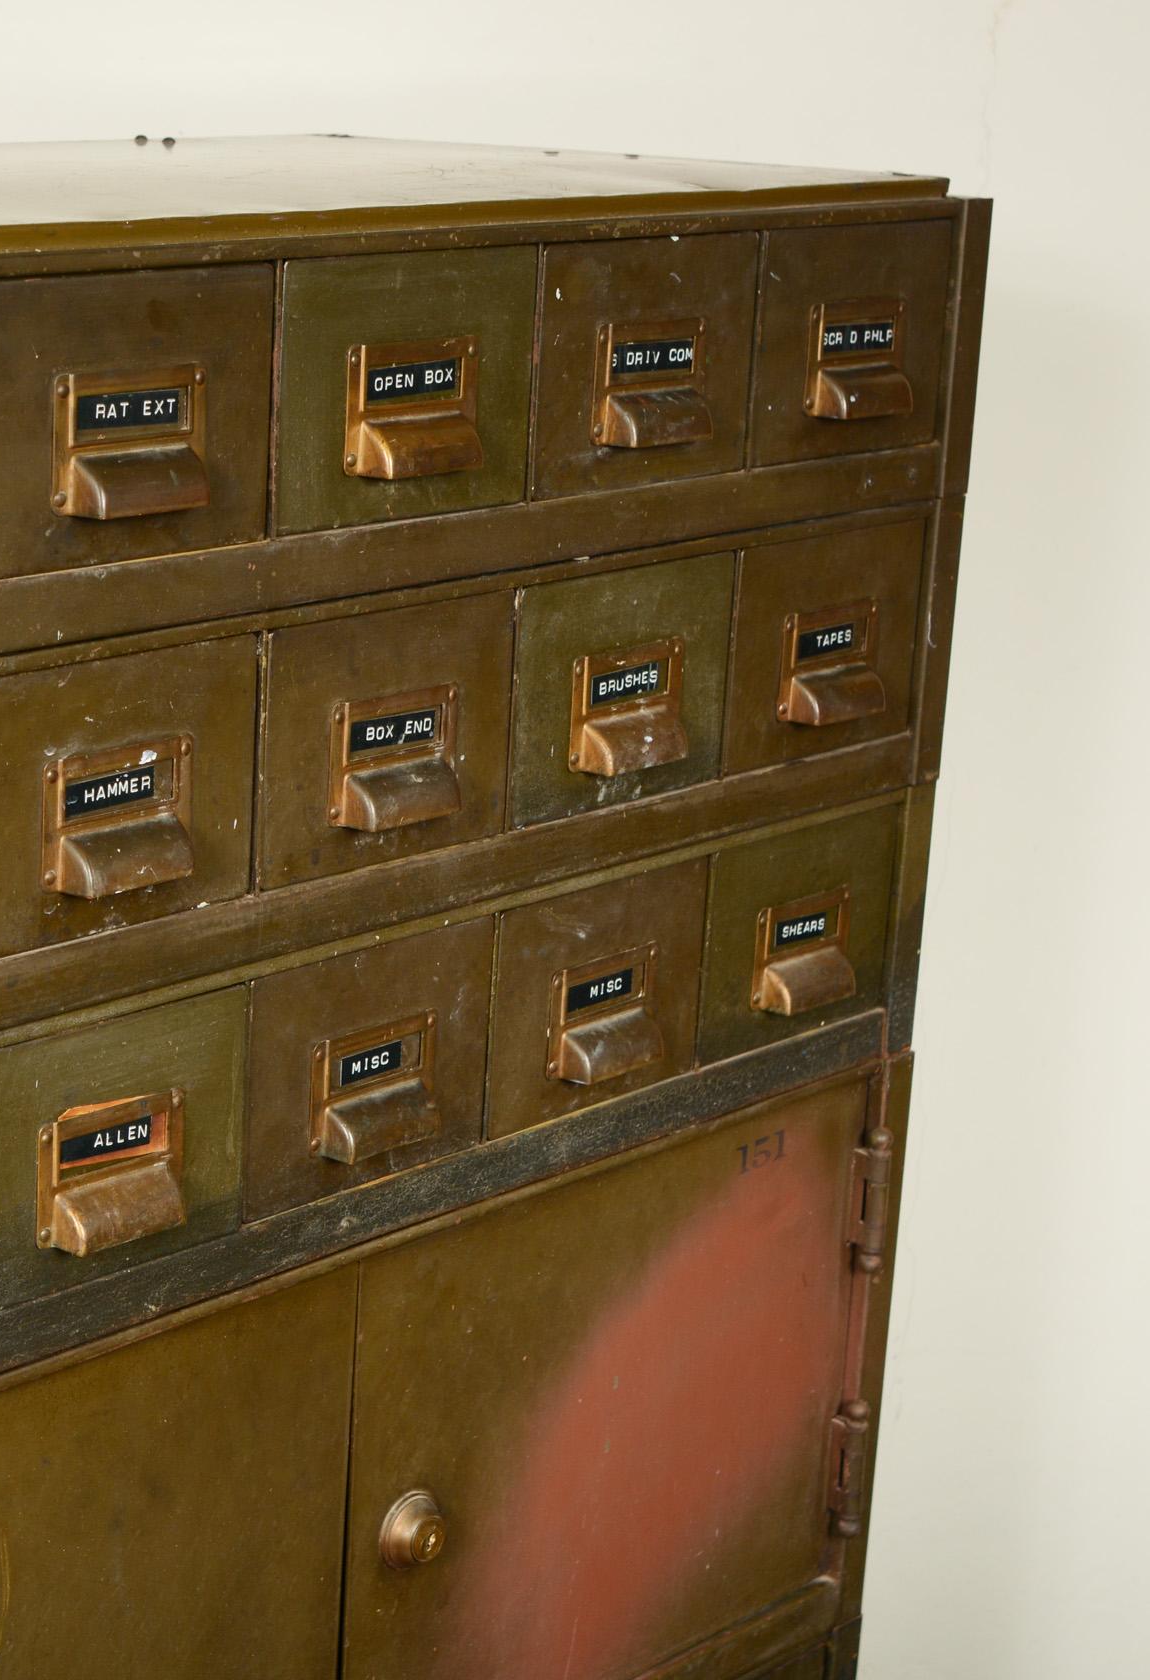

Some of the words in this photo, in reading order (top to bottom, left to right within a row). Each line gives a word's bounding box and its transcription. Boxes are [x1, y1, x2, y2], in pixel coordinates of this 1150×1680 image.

[849, 330, 858, 344] D
[863, 329, 893, 343] PHLP
[626, 350, 661, 366] DRIV
[668, 347, 694, 362] COM
[374, 373, 414, 392] OPEN
[424, 367, 454, 385] BOX
[95, 401, 130, 419] RAT
[142, 398, 176, 416] EXT
[816, 629, 852, 647] TAPES
[598, 670, 658, 696] BRUSHES
[365, 724, 394, 741] BOX
[404, 717, 433, 735] END
[83, 776, 151, 804] HAMMER
[781, 917, 825, 938] SHEARS
[589, 977, 623, 998] MISC
[351, 1051, 390, 1075] MISC
[93, 1124, 148, 1148] ALLEN
[737, 1129, 786, 1175] 151
